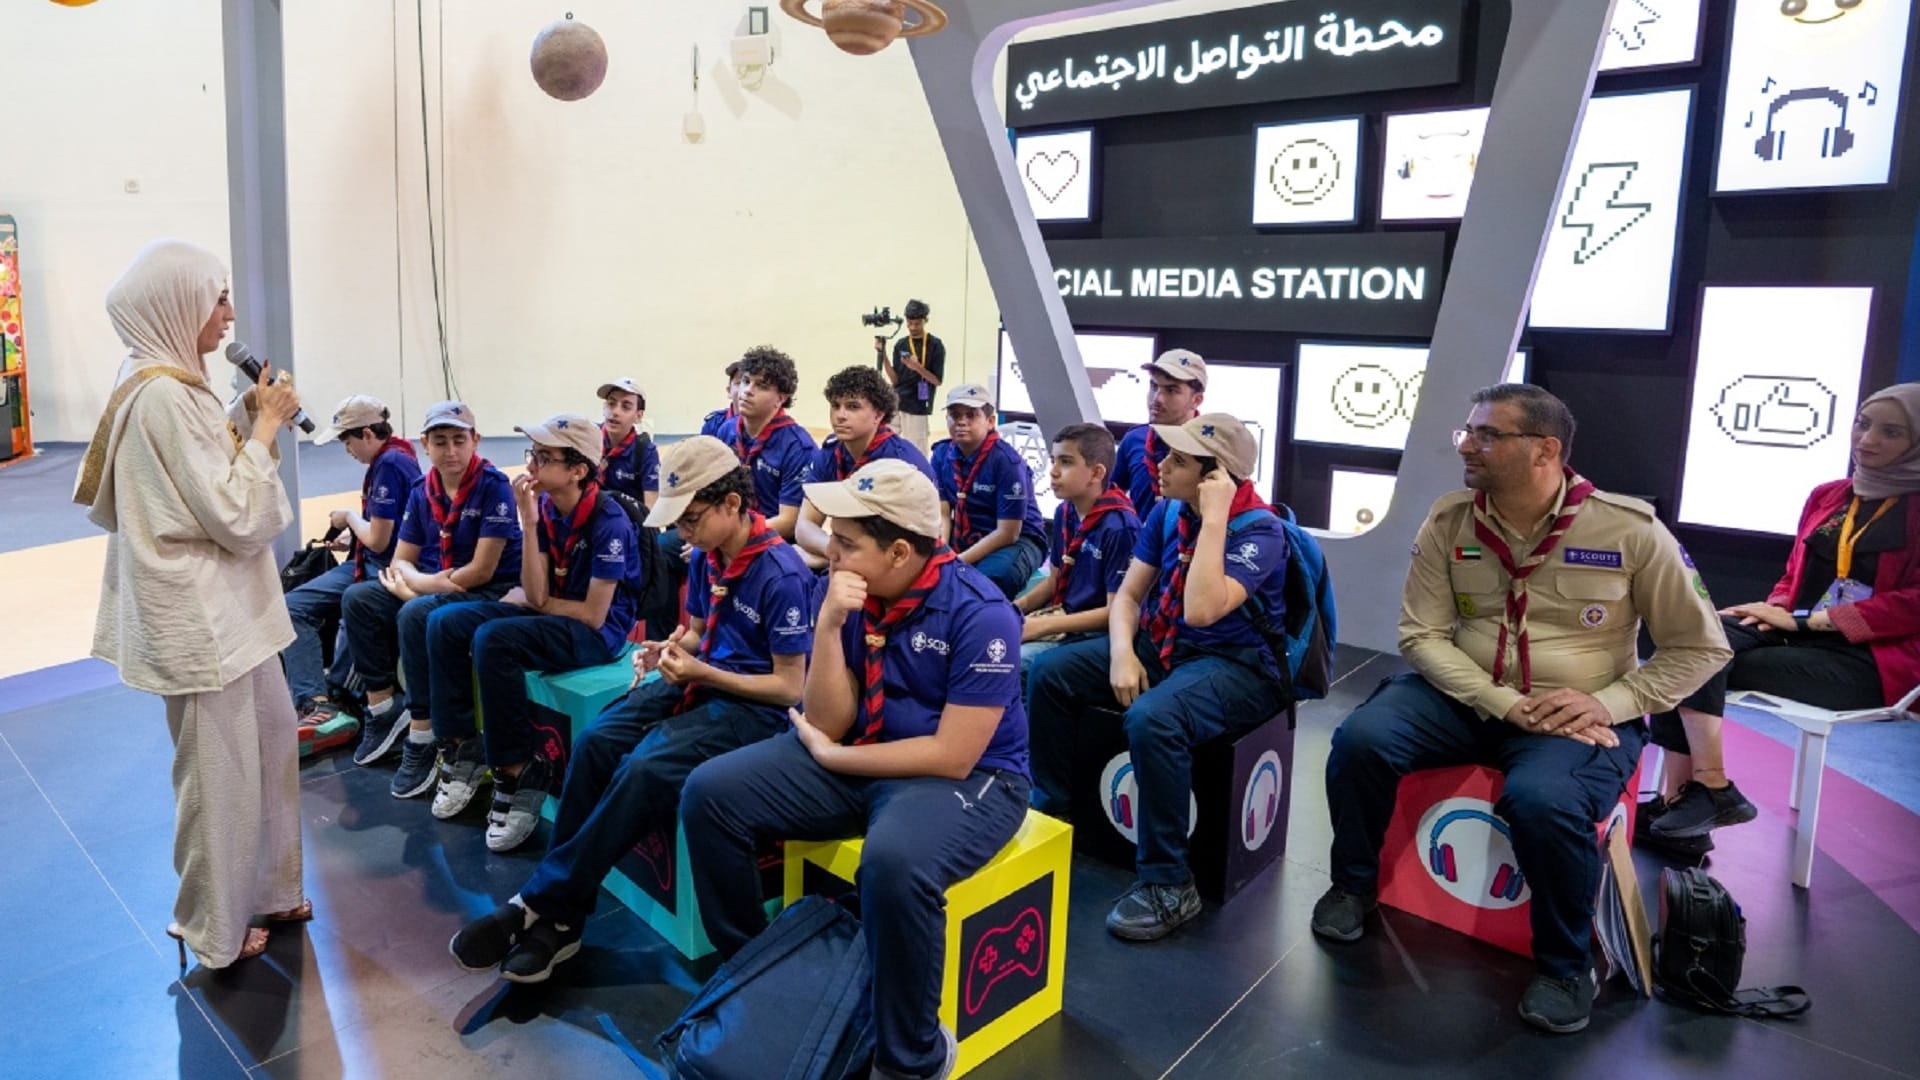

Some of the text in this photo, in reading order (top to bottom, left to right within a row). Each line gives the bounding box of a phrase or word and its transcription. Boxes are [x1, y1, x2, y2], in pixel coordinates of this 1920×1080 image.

[1015, 13, 1443, 110] محطة التواصل الاجتماعي
[1054, 266, 1425, 300] CIAL MEDIA STATION
[1579, 551, 1618, 562] SCOUTS
